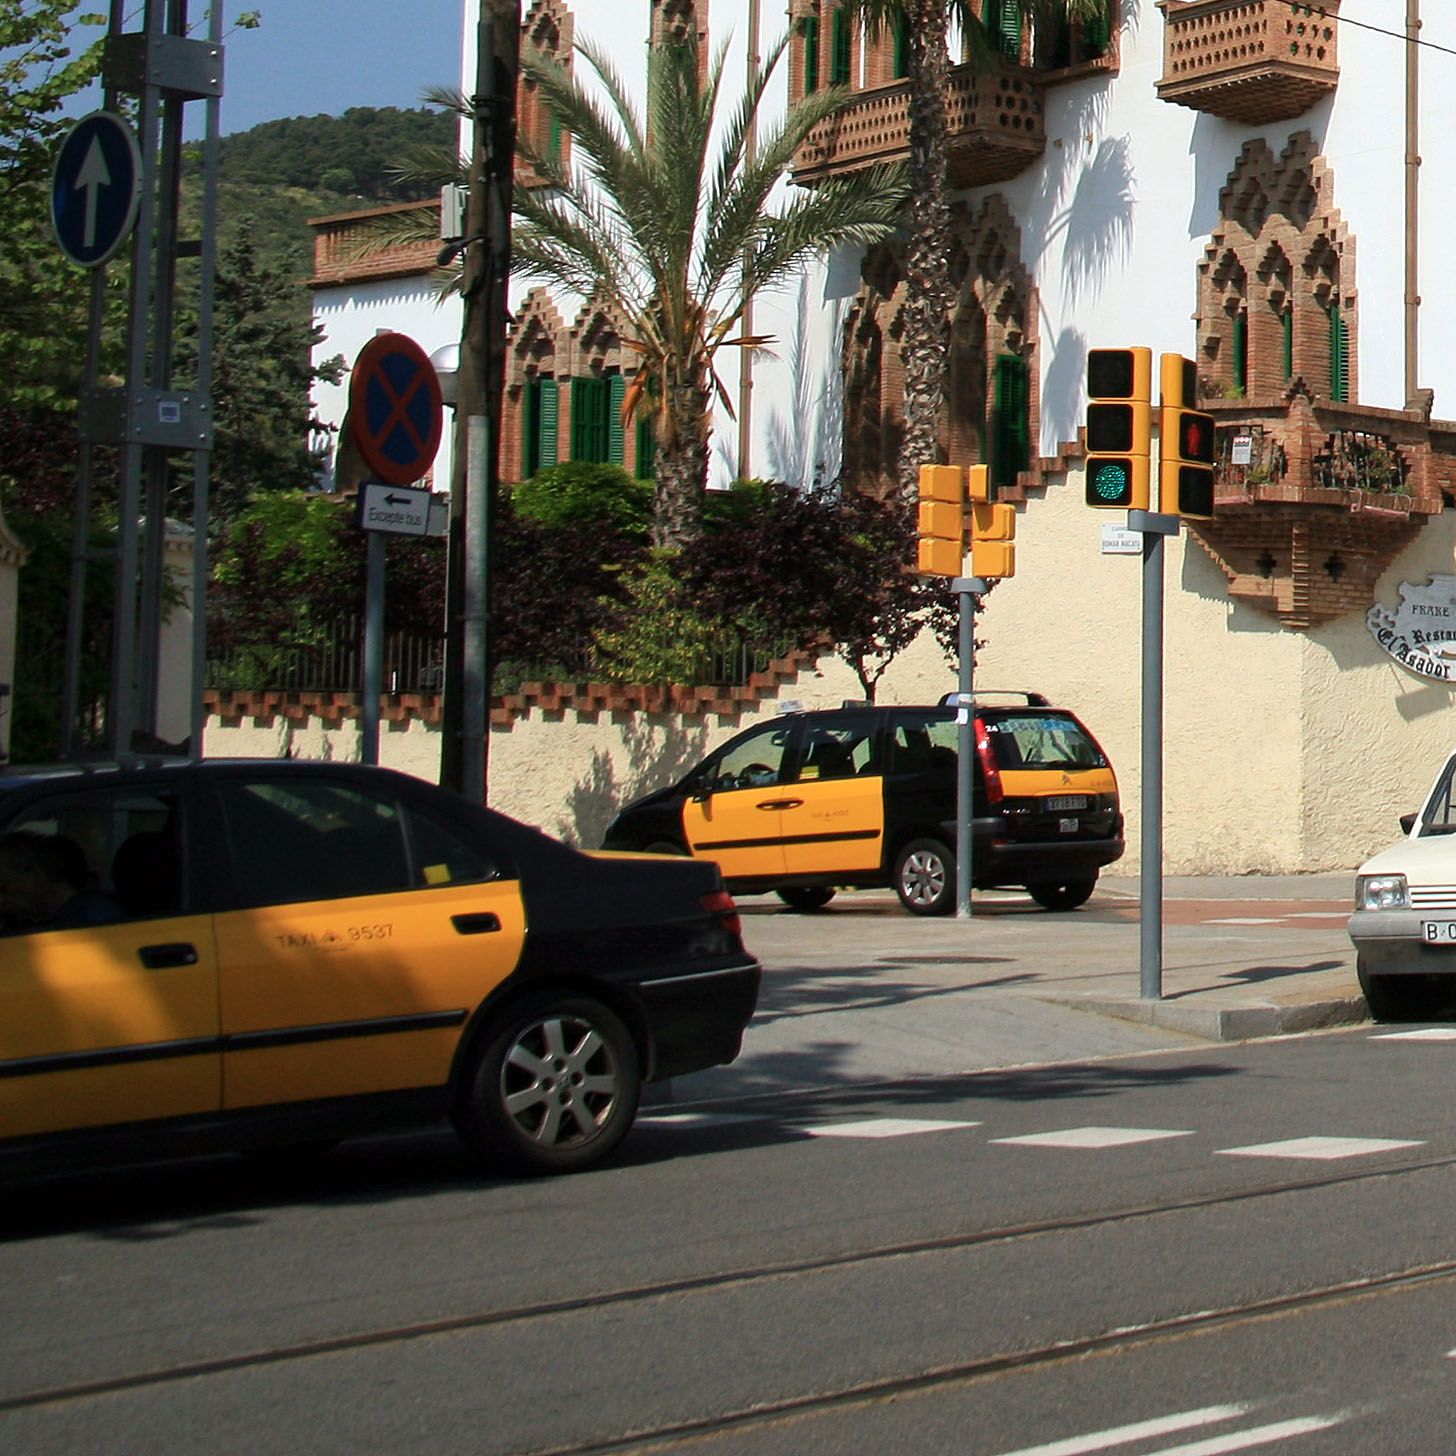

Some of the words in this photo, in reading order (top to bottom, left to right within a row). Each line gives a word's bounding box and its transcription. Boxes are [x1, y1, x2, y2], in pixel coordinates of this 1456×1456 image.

[405, 510, 422, 526] bus
[1377, 627, 1398, 652] El
[1395, 643, 1451, 678] Asador
[1426, 923, 1438, 941] B
